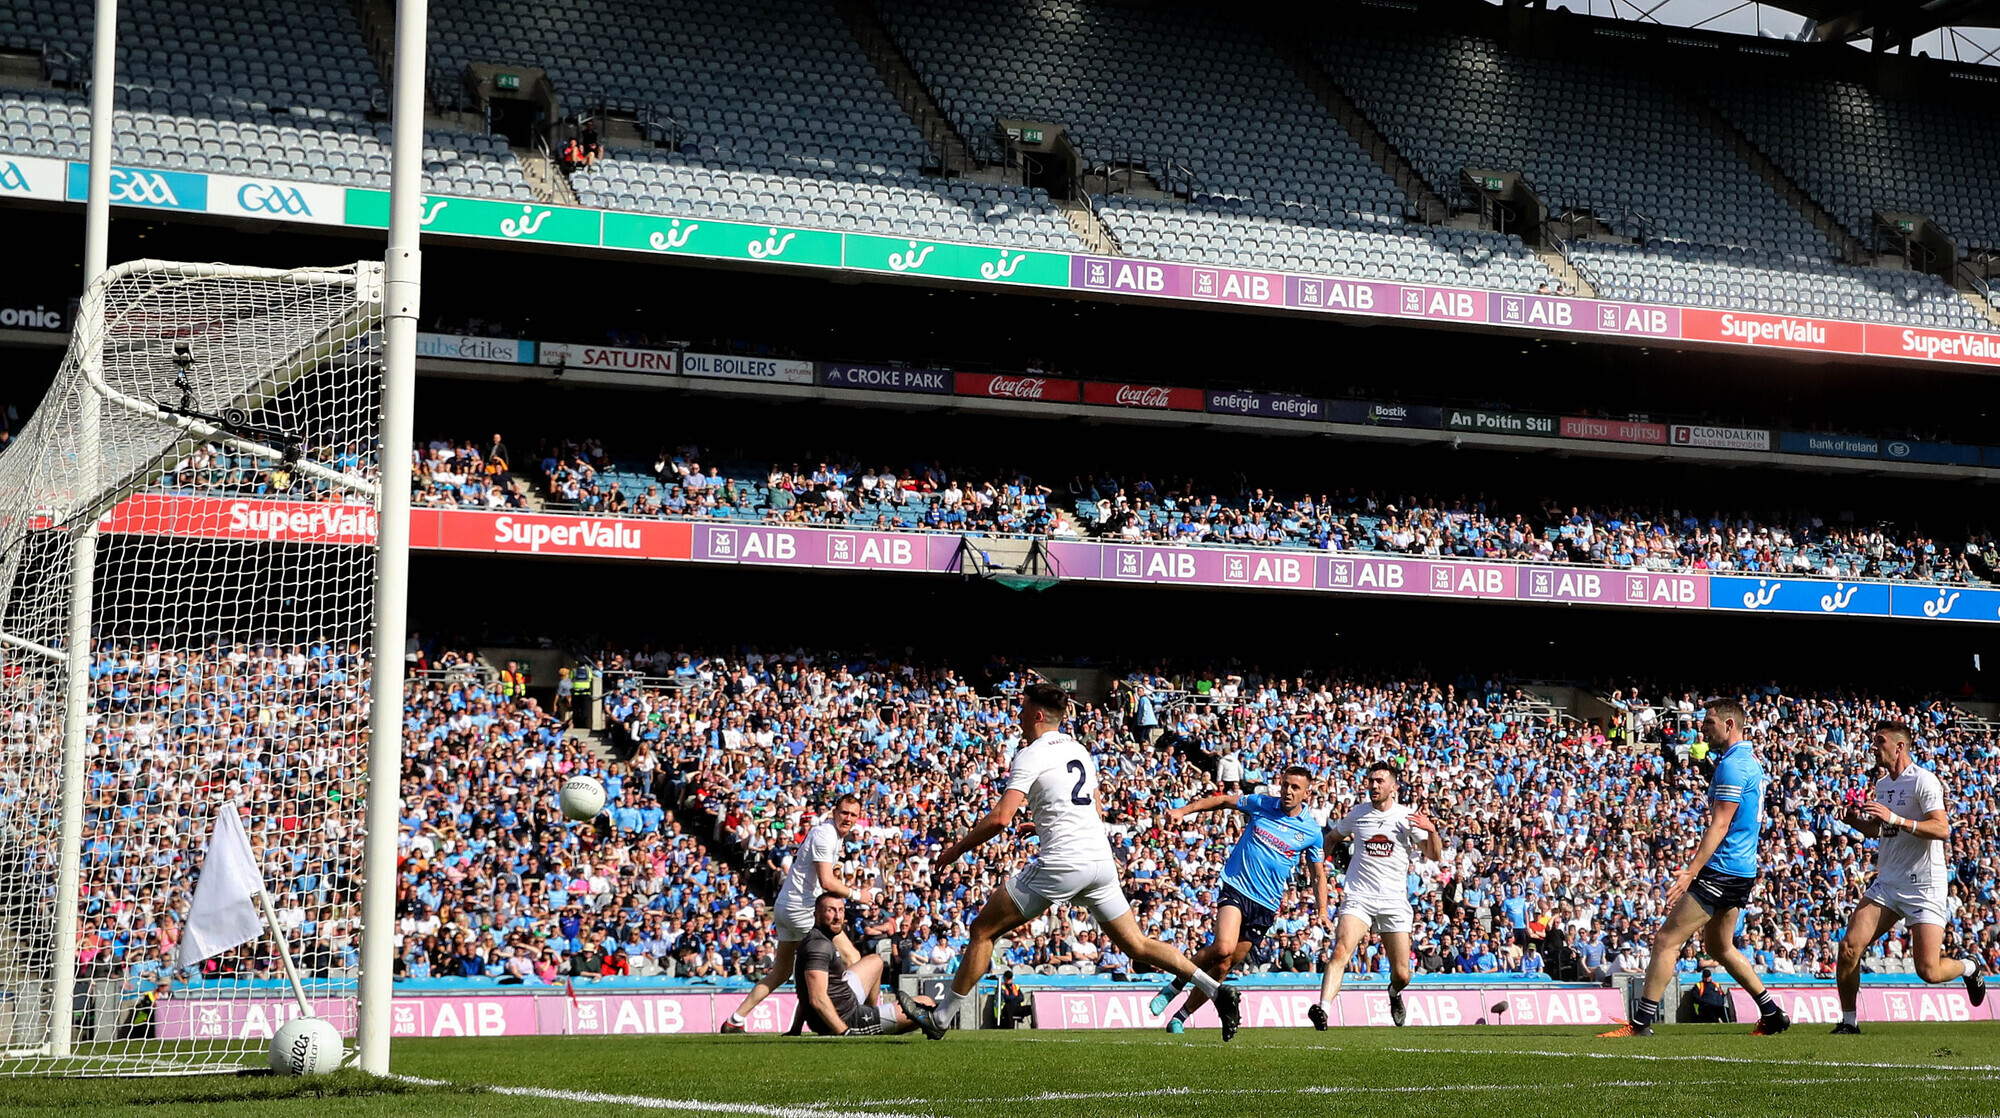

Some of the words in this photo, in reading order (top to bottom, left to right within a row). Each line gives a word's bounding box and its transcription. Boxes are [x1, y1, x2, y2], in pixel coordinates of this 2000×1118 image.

[238, 184, 312, 217] GAA
[500, 205, 551, 237] eir
[649, 219, 698, 250] eir
[747, 228, 795, 259] eir
[888, 241, 934, 271] eir
[980, 249, 1026, 280] eir
[1091, 275, 1105, 284] AIB
[1115, 265, 1164, 291] AIB
[1198, 285, 1212, 294] AIB
[1222, 274, 1270, 300] AIB
[1303, 294, 1318, 303] AIB
[1327, 283, 1374, 309] AIB
[1406, 302, 1420, 310] AIB
[1428, 292, 1474, 317] AIB
[1506, 309, 1521, 319] AIB
[1529, 301, 1573, 326] AIB
[1602, 318, 1616, 328] AIB
[1625, 309, 1668, 333] AIB
[1721, 315, 1825, 344] SuperValu
[1902, 329, 2000, 359] SuperValu
[583, 349, 671, 370] SATURN
[684, 357, 709, 372] OIL
[714, 359, 776, 377] BOILERS
[847, 368, 899, 386] CROKE
[904, 372, 944, 388] PARK
[1376, 406, 1406, 417] Bostik
[1451, 412, 1471, 426] An
[1526, 417, 1552, 431] Stil
[1567, 420, 1607, 437] FUJITSU
[1620, 425, 1660, 441] FUJITSU
[1693, 427, 1765, 441] CLONDALKIN
[1810, 439, 1832, 450] Bank
[1834, 441, 1845, 451] of
[1846, 442, 1877, 454] Ireland
[495, 517, 641, 551] SuperValu
[742, 532, 796, 559] AIB
[714, 545, 730, 554] AIB
[833, 551, 849, 560] AIB
[860, 538, 912, 565] AIB
[1122, 566, 1137, 574] AIB
[1147, 552, 1196, 578] AIB
[1253, 558, 1301, 583] AIB
[1357, 563, 1404, 588] AIB
[1334, 575, 1348, 583] AIB
[1458, 568, 1504, 593] AIB
[1557, 574, 1602, 598] AIB
[1652, 579, 1696, 603] AIB
[1743, 580, 1781, 609] eir
[1820, 583, 1858, 612] eir
[1923, 589, 1960, 617] eir
[1067, 760, 1091, 805] 2
[935, 982, 946, 1000] 2
[432, 1002, 506, 1036] AIB
[613, 999, 685, 1034] AIB
[1071, 1014, 1090, 1024] AIB
[1103, 995, 1166, 1028] AIB
[1256, 995, 1313, 1028] AIB
[1405, 995, 1462, 1026] AIB
[1517, 1011, 1533, 1020] AIB
[1546, 994, 1602, 1023] AIB
[1792, 996, 1843, 1024] AIB
[1894, 1010, 1909, 1019] AIB
[1919, 994, 1970, 1021] AIB
[200, 1024, 222, 1035] AIB
[394, 1023, 416, 1034] AIB
[577, 1018, 598, 1030] AIB
[753, 1019, 772, 1030] AIB
